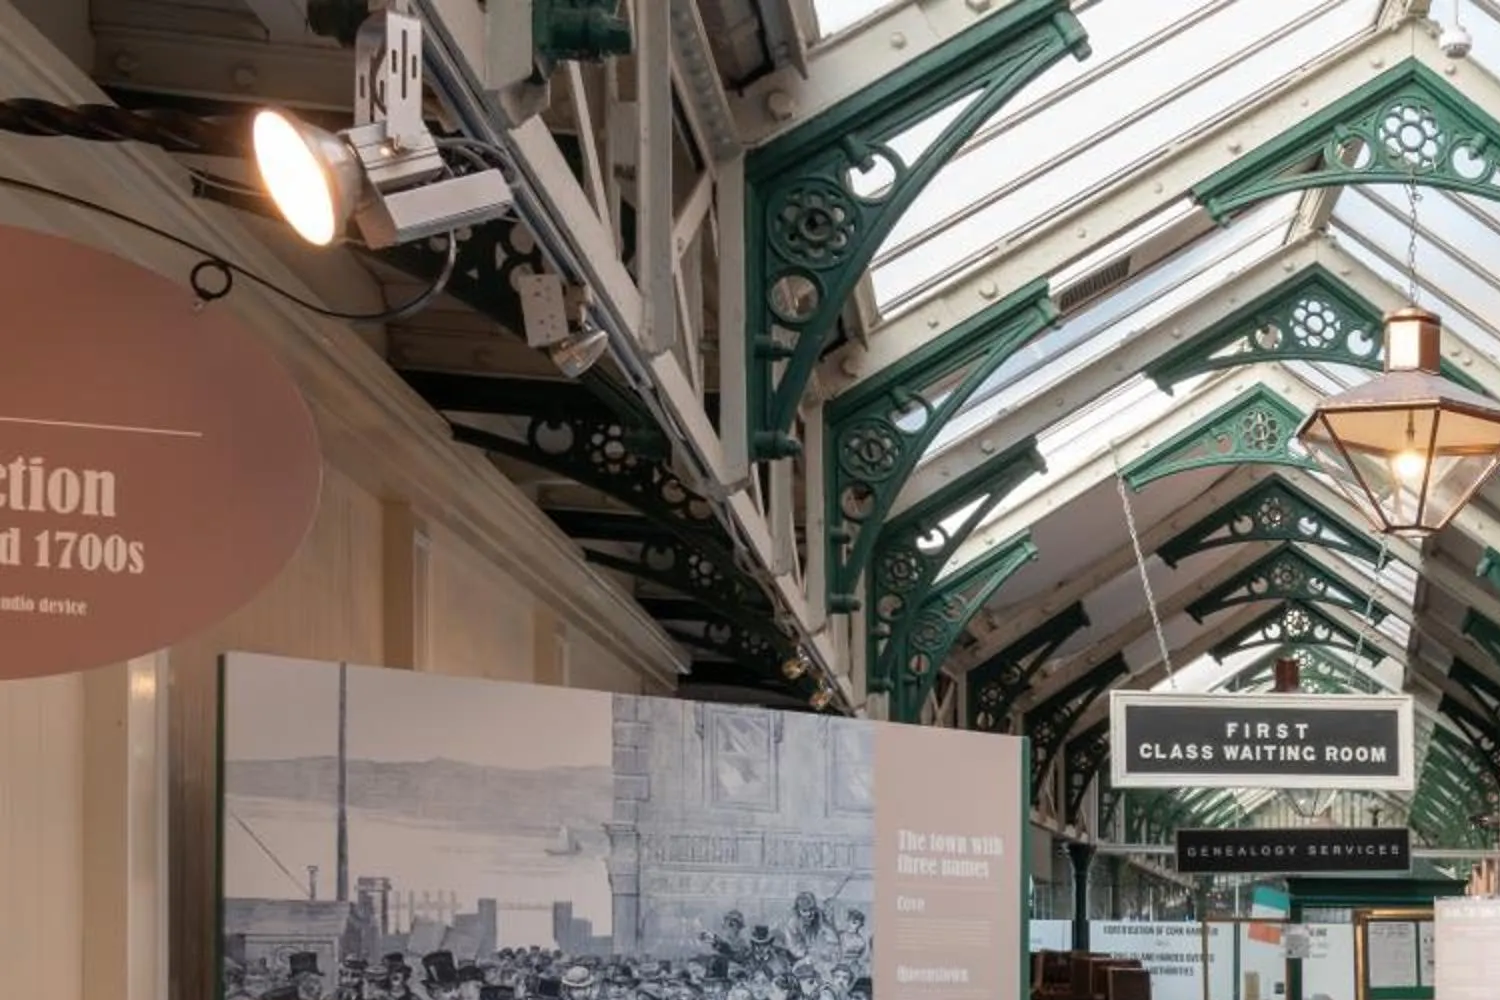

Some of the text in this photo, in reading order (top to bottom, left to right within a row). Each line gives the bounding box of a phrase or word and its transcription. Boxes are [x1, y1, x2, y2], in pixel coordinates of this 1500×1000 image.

[35, 529, 144, 574] 1700s
[38, 597, 87, 615] device
[1226, 722, 1310, 740] FIRST
[1139, 743, 1387, 763] CLASS WAITING ROOM
[898, 829, 1004, 856] The town with
[1187, 844, 1400, 857] GENEALOGY SERVICES
[897, 853, 989, 879] three names
